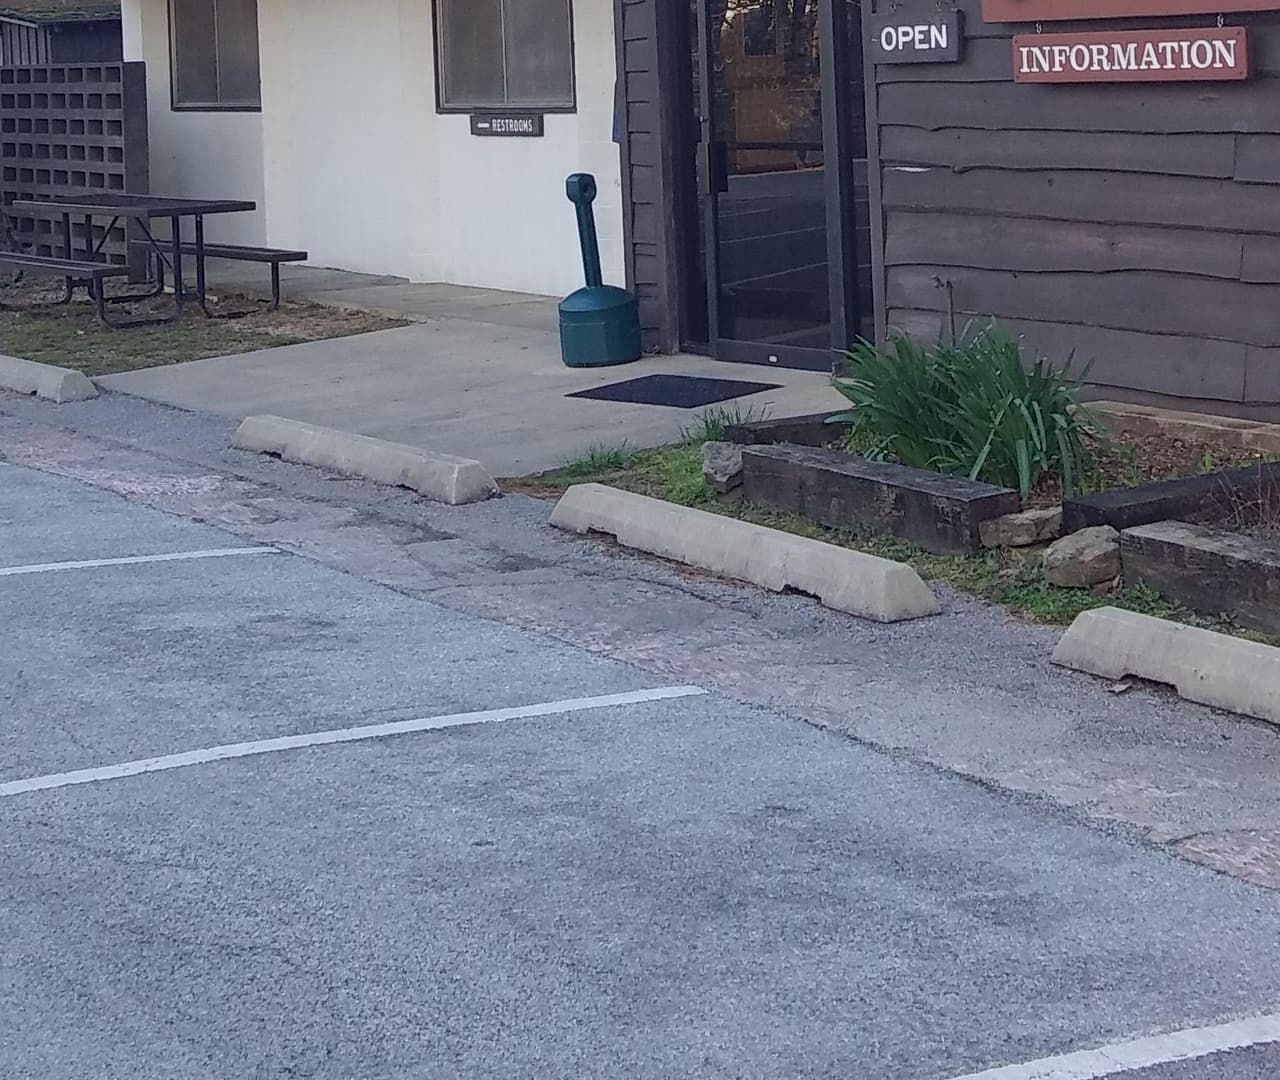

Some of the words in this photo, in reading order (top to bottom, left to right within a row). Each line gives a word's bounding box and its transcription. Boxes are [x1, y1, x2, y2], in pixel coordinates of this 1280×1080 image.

[880, 24, 947, 51] OPEN
[1020, 39, 1237, 73] INFORMATION
[492, 118, 533, 132] RESTROOMS
